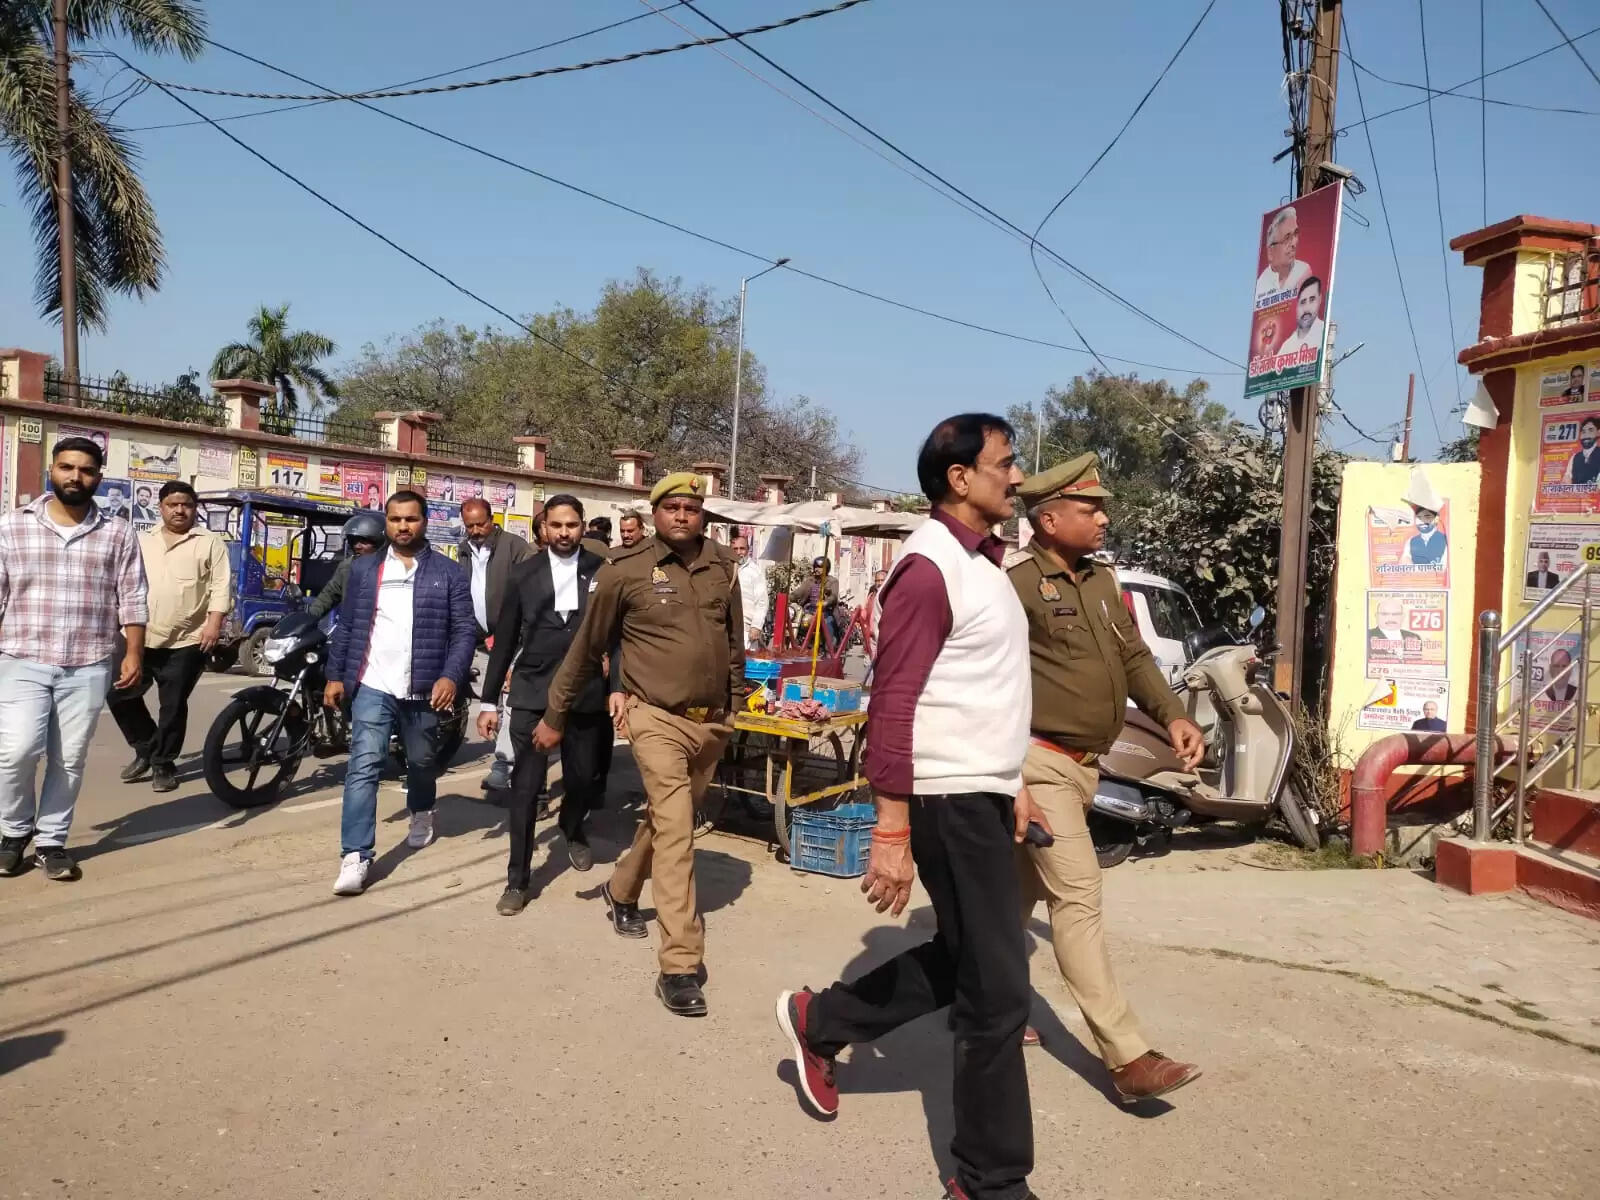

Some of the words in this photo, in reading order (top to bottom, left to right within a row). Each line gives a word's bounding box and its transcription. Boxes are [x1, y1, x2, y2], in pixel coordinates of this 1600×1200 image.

[1276, 351, 1299, 375] कुमार
[22, 423, 40, 434] 100
[1558, 423, 1577, 441] 271
[240, 473, 255, 481] 100
[271, 469, 304, 486] 117
[397, 470, 409, 478] 100
[1412, 611, 1441, 629] 276
